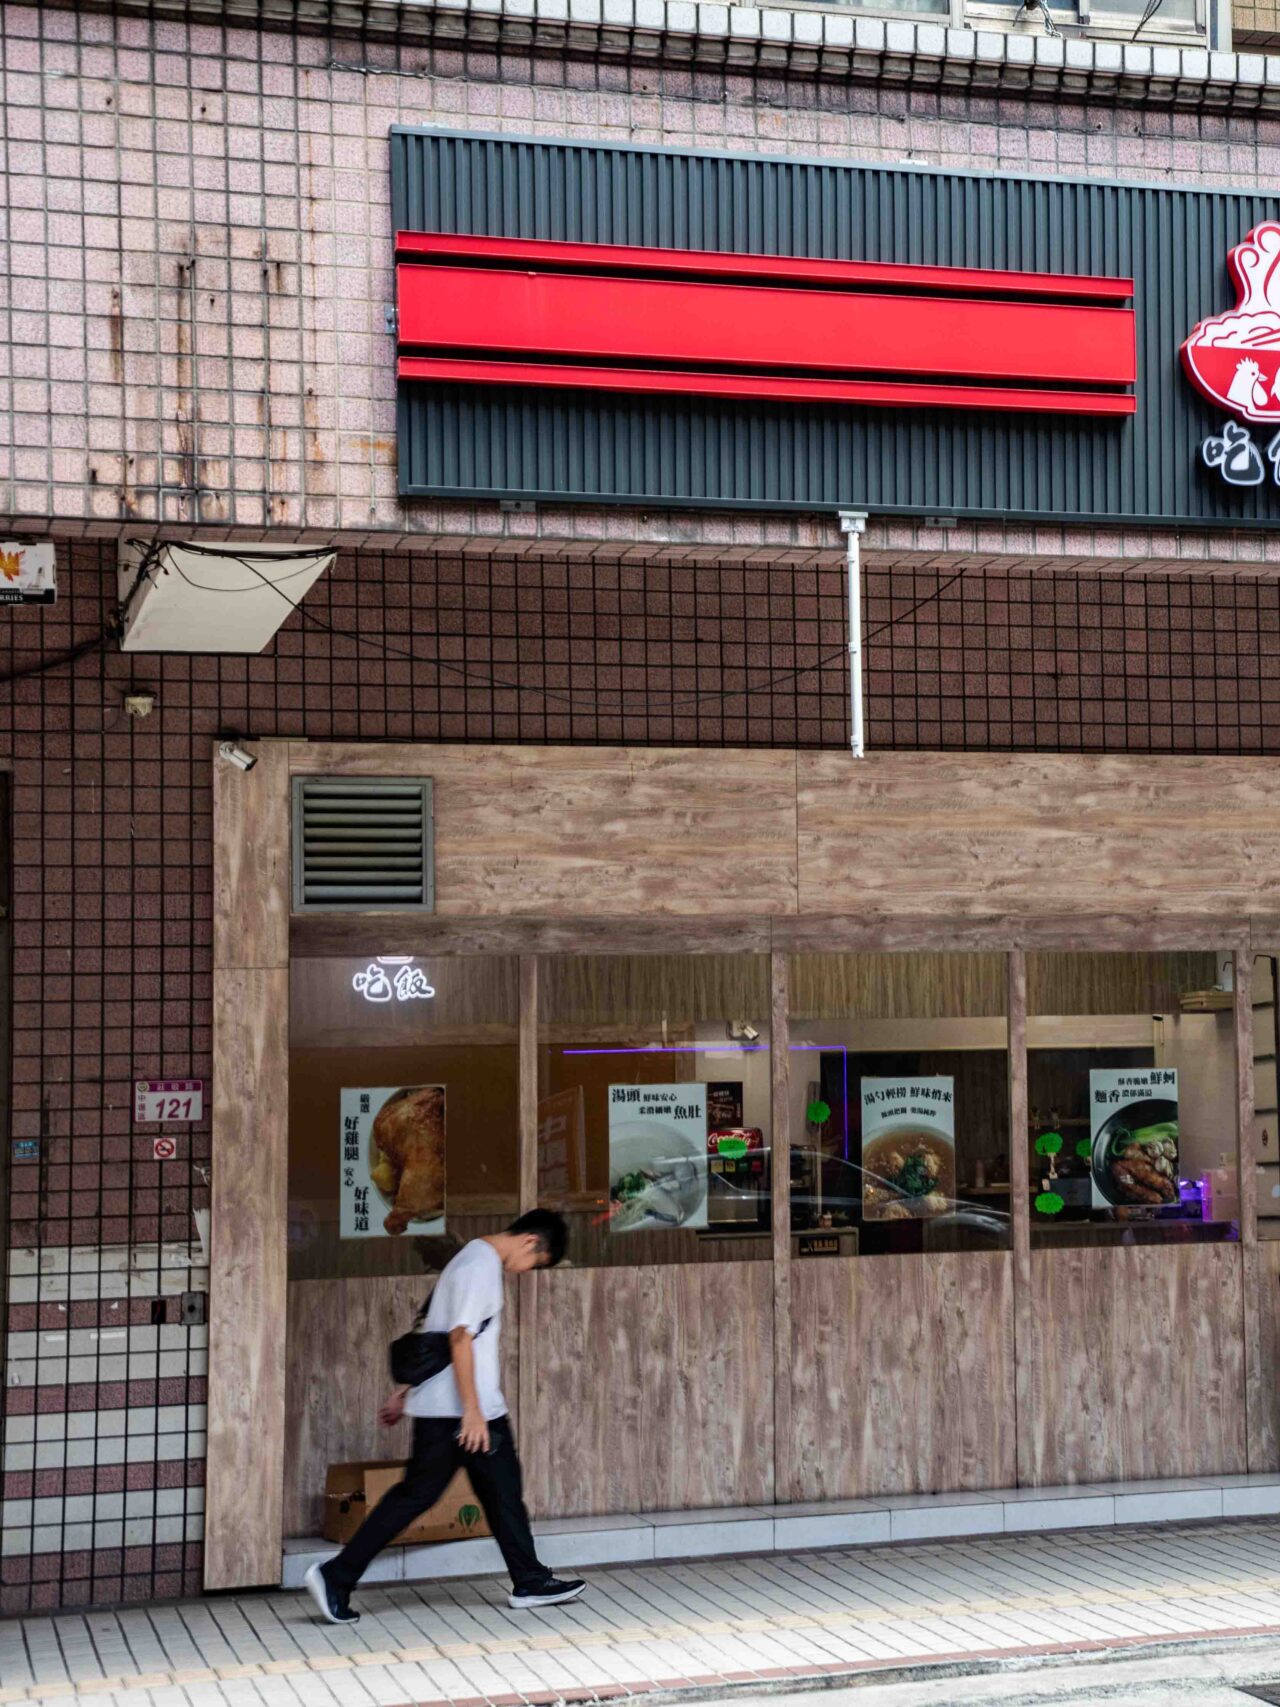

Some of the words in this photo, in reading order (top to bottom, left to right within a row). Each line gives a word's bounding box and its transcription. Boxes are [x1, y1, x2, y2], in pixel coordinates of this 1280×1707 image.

[352, 964, 436, 1003] 吃飯
[612, 1088, 640, 1103] 湯頭
[156, 1098, 192, 1119] 121
[674, 1104, 702, 1119] 魚肚
[344, 1116, 359, 1161] 好雞腿
[344, 1167, 354, 1187] 安心
[354, 1186, 369, 1231] 好味道
